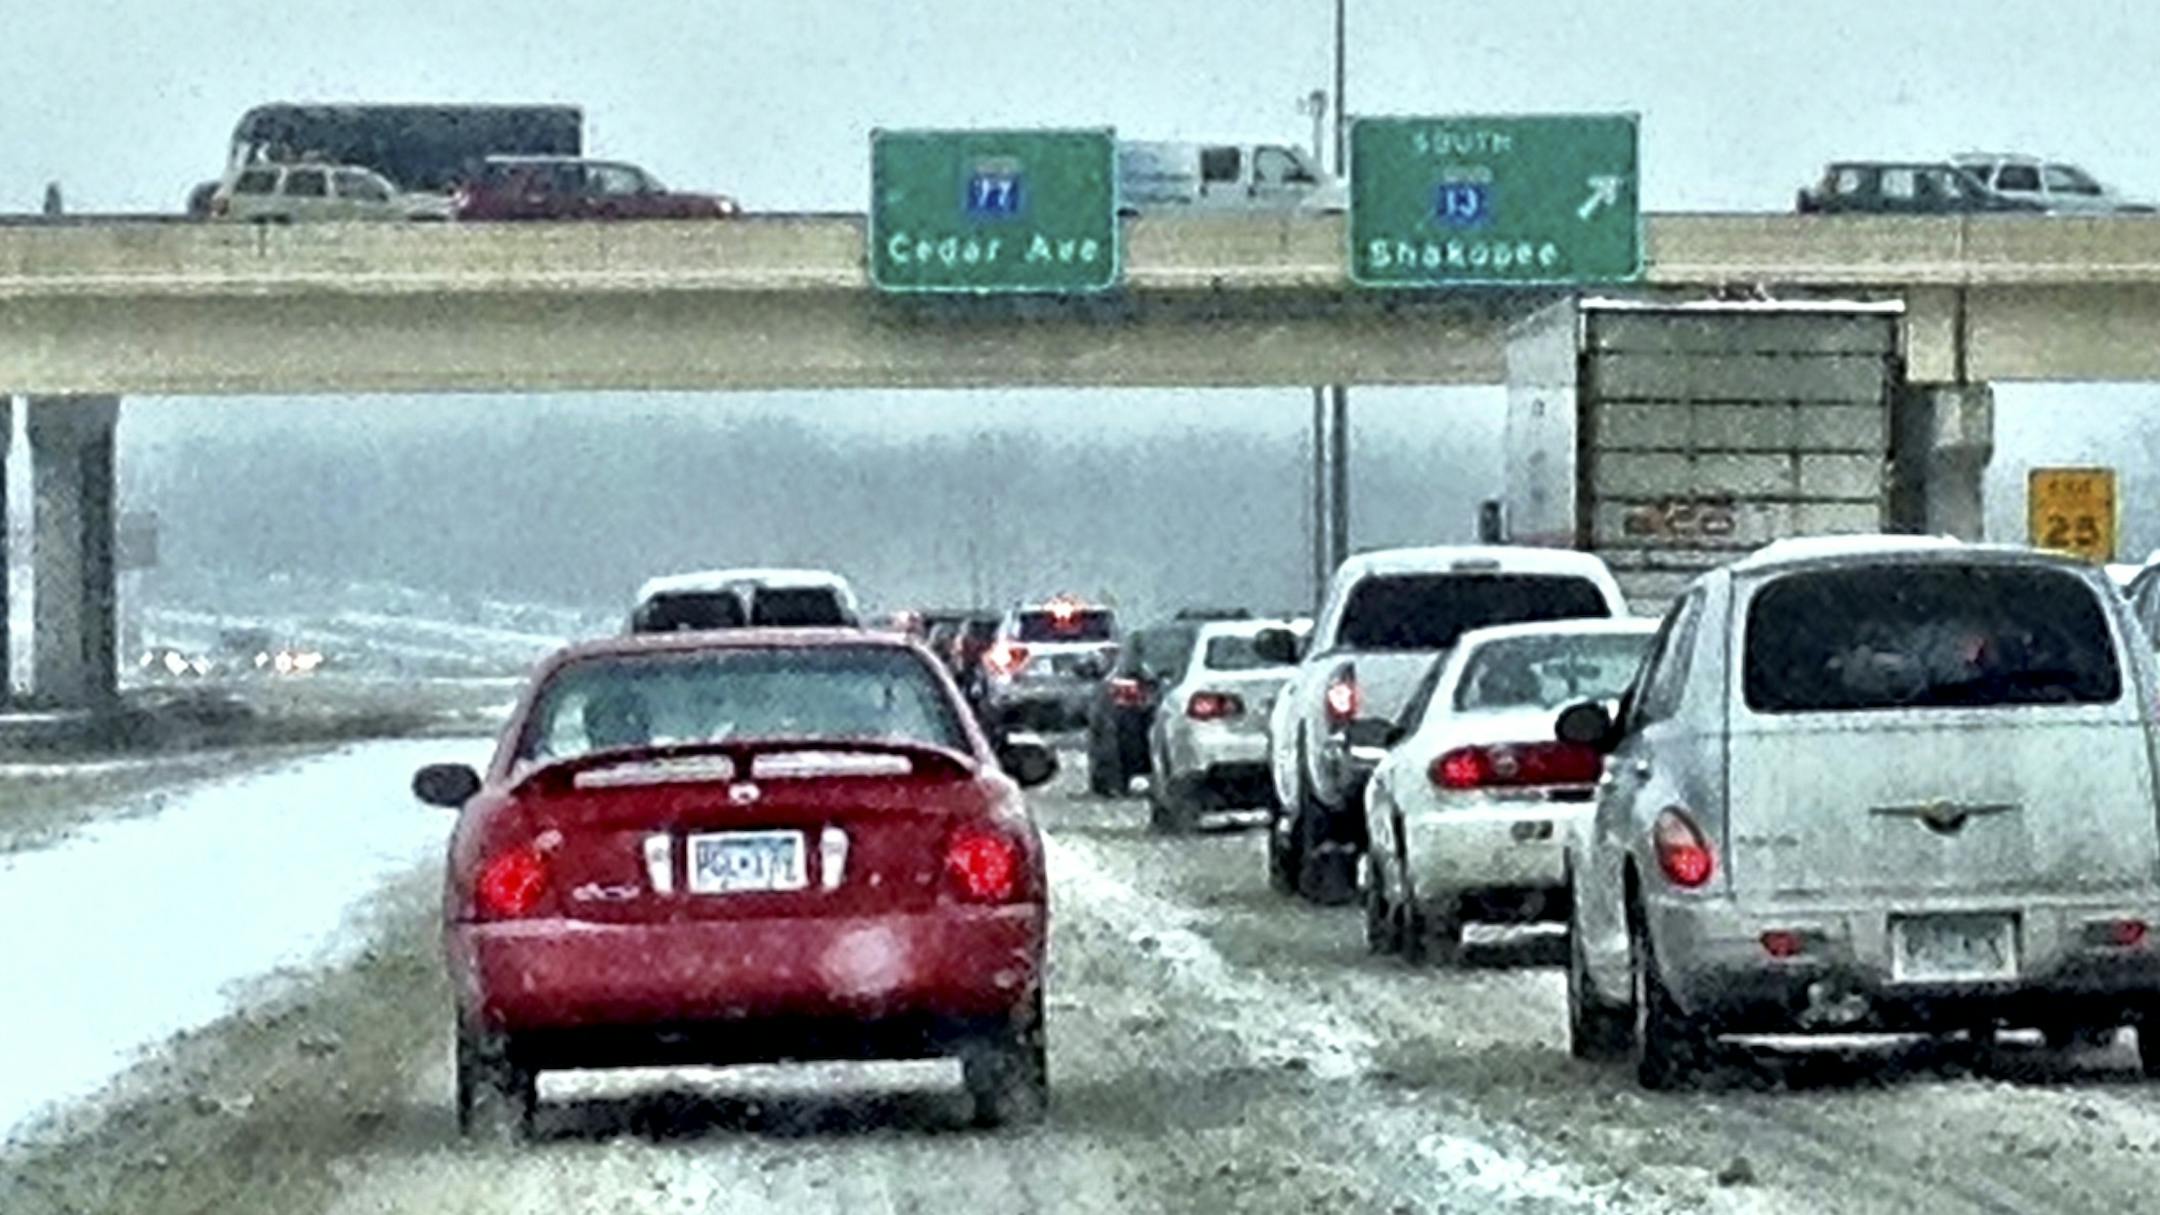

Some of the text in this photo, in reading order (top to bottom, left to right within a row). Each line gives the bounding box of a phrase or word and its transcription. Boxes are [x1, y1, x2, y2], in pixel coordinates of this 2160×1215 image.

[1412, 130, 1512, 155] SOUTH
[974, 177, 1012, 207] 77
[1446, 188, 1479, 217] 13
[887, 232, 1098, 266] Cedar Ave
[1369, 238, 1559, 271] Shakopee
